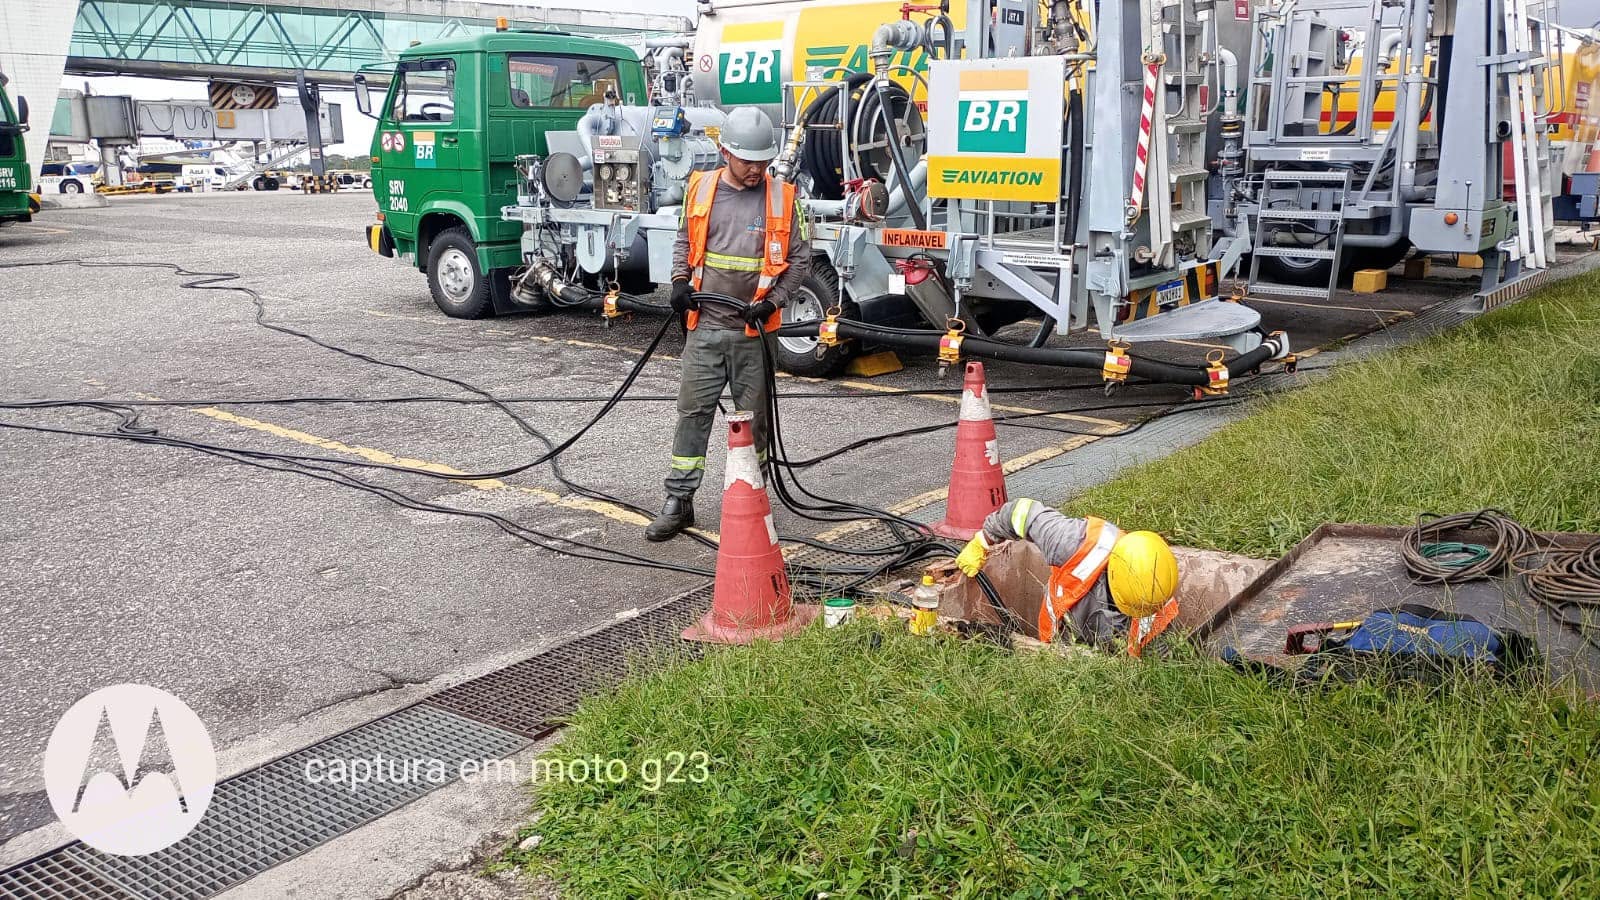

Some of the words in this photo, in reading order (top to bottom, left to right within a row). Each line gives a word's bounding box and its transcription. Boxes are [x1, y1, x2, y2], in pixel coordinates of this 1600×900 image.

[723, 50, 775, 84] BR
[963, 100, 1020, 132] BR
[416, 145, 434, 160] BR
[957, 170, 1043, 186] AVIATION
[389, 180, 405, 195] SRV
[389, 196, 409, 212] 2040
